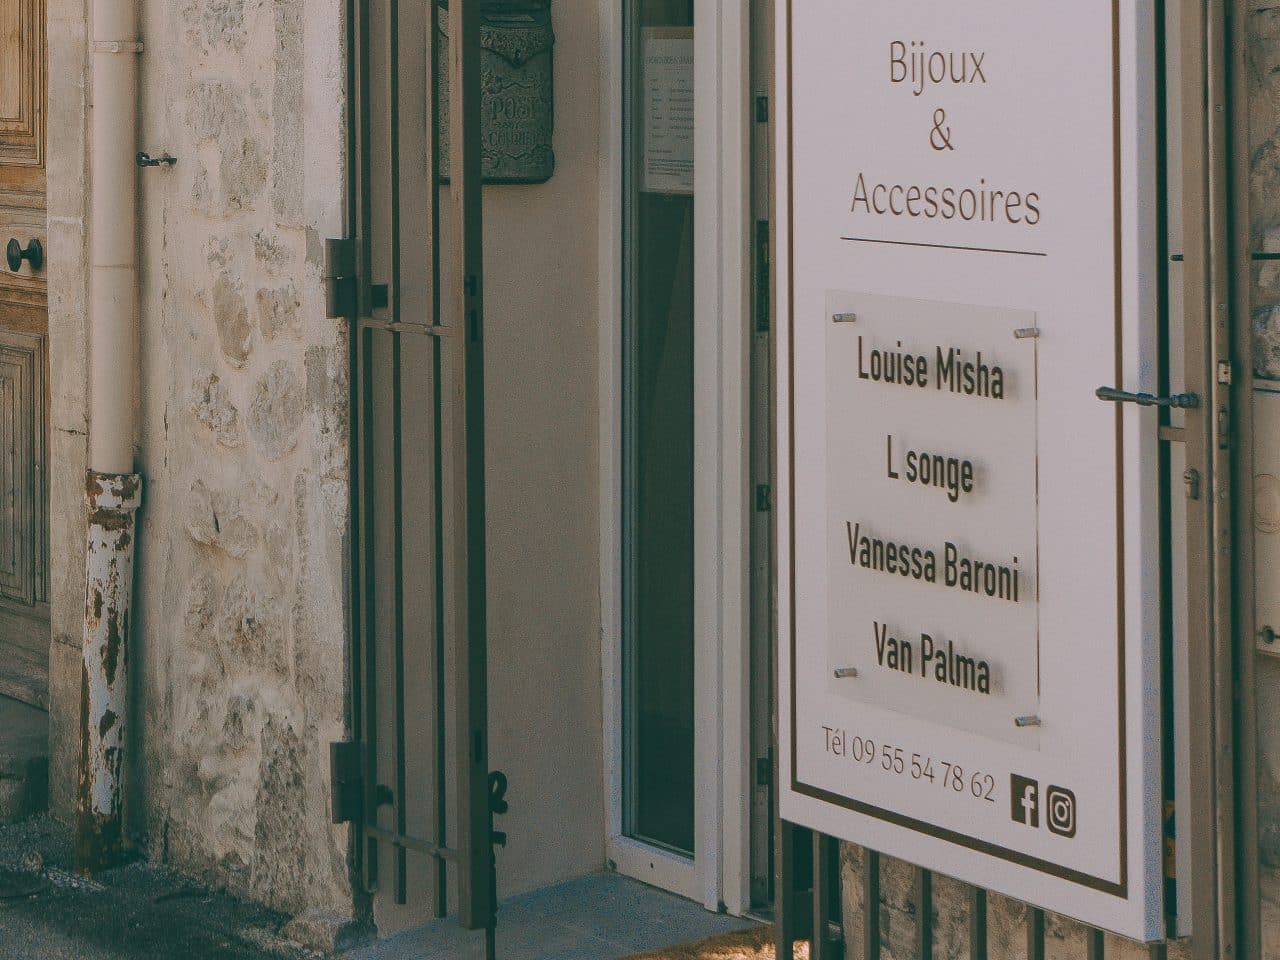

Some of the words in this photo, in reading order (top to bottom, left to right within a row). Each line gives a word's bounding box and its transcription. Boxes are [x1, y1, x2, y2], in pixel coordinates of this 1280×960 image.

[888, 40, 987, 97] Bijoux
[928, 107, 955, 152] &
[850, 172, 1042, 226] Accessoires
[857, 335, 928, 388] Louise
[935, 345, 1005, 400] Misha
[887, 434, 899, 480] L
[906, 450, 974, 503] songe
[846, 520, 936, 584] Vanessa
[944, 541, 1019, 603] Baroni
[873, 620, 913, 674] Van
[920, 632, 991, 696] Palma
[821, 725, 846, 757] Tél
[852, 736, 876, 764] 09
[881, 744, 904, 774] 55
[910, 753, 936, 784] 54
[940, 761, 965, 792] 78
[970, 771, 996, 803] 62
